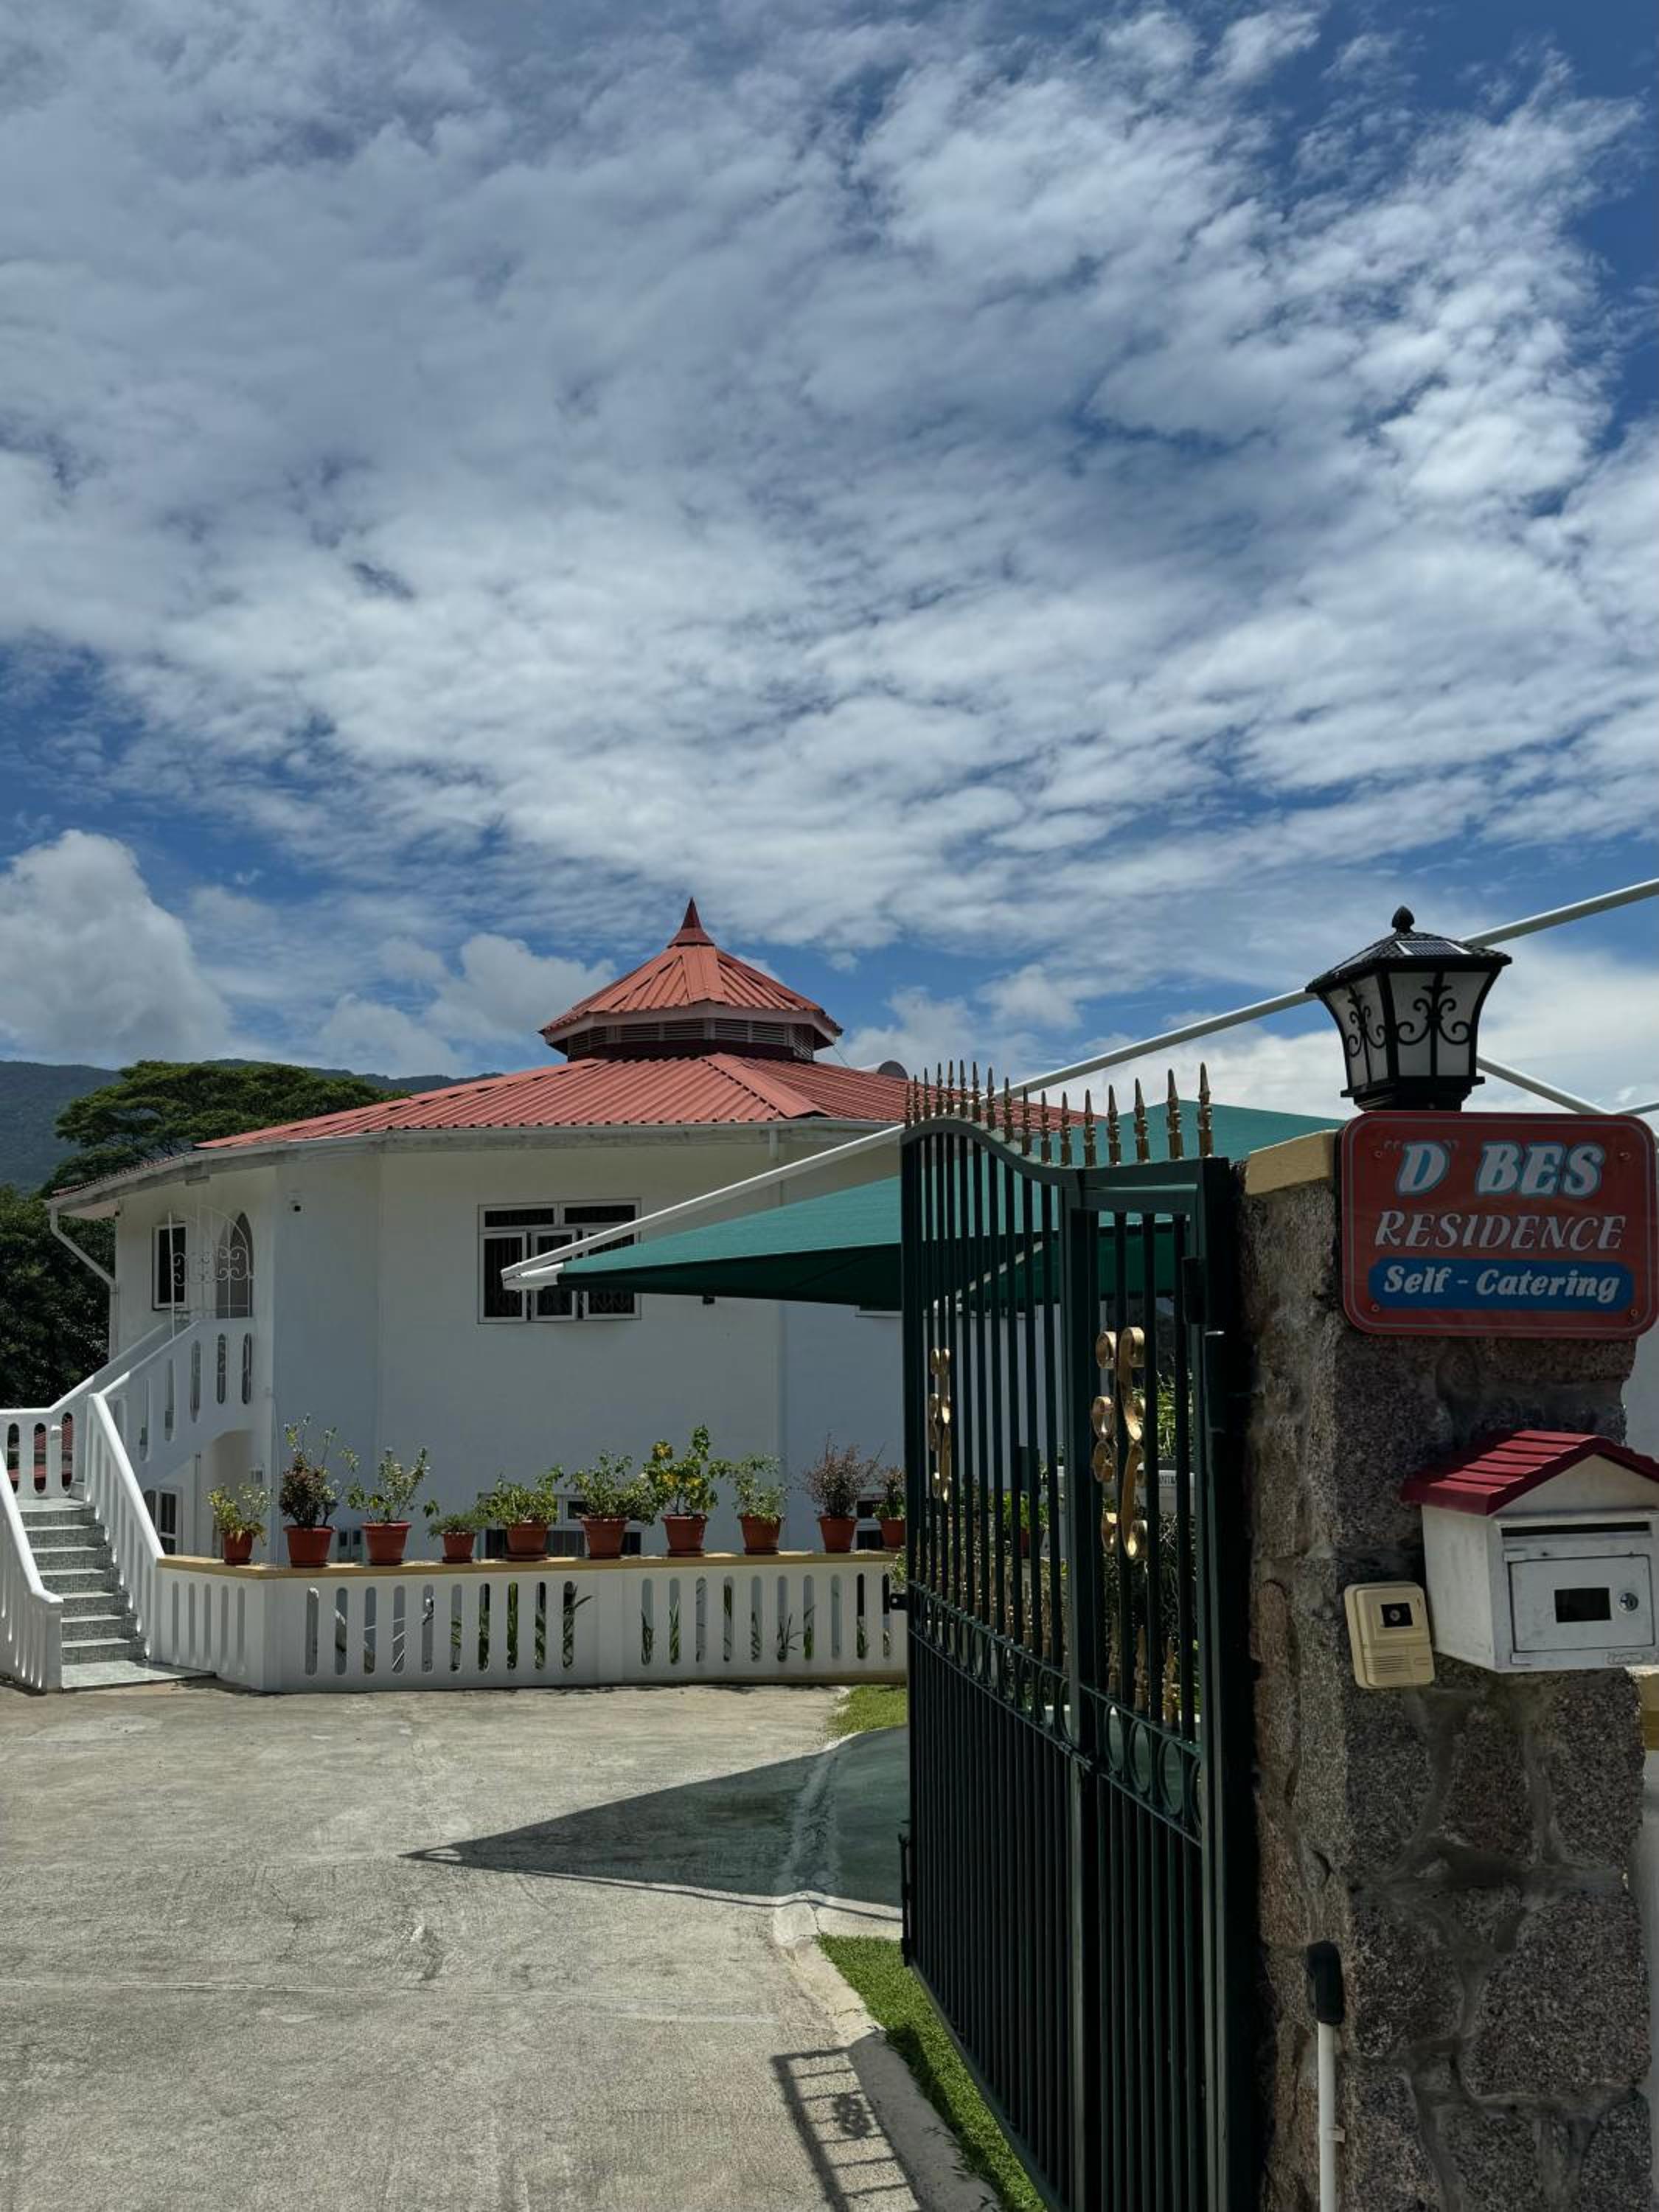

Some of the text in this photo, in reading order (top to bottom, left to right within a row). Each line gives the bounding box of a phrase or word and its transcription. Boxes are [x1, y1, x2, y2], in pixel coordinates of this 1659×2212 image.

[1475, 1140, 1605, 1199] BES
[1374, 1210, 1627, 1251] RESIDENCE
[1475, 1268, 1620, 1304] Catering
